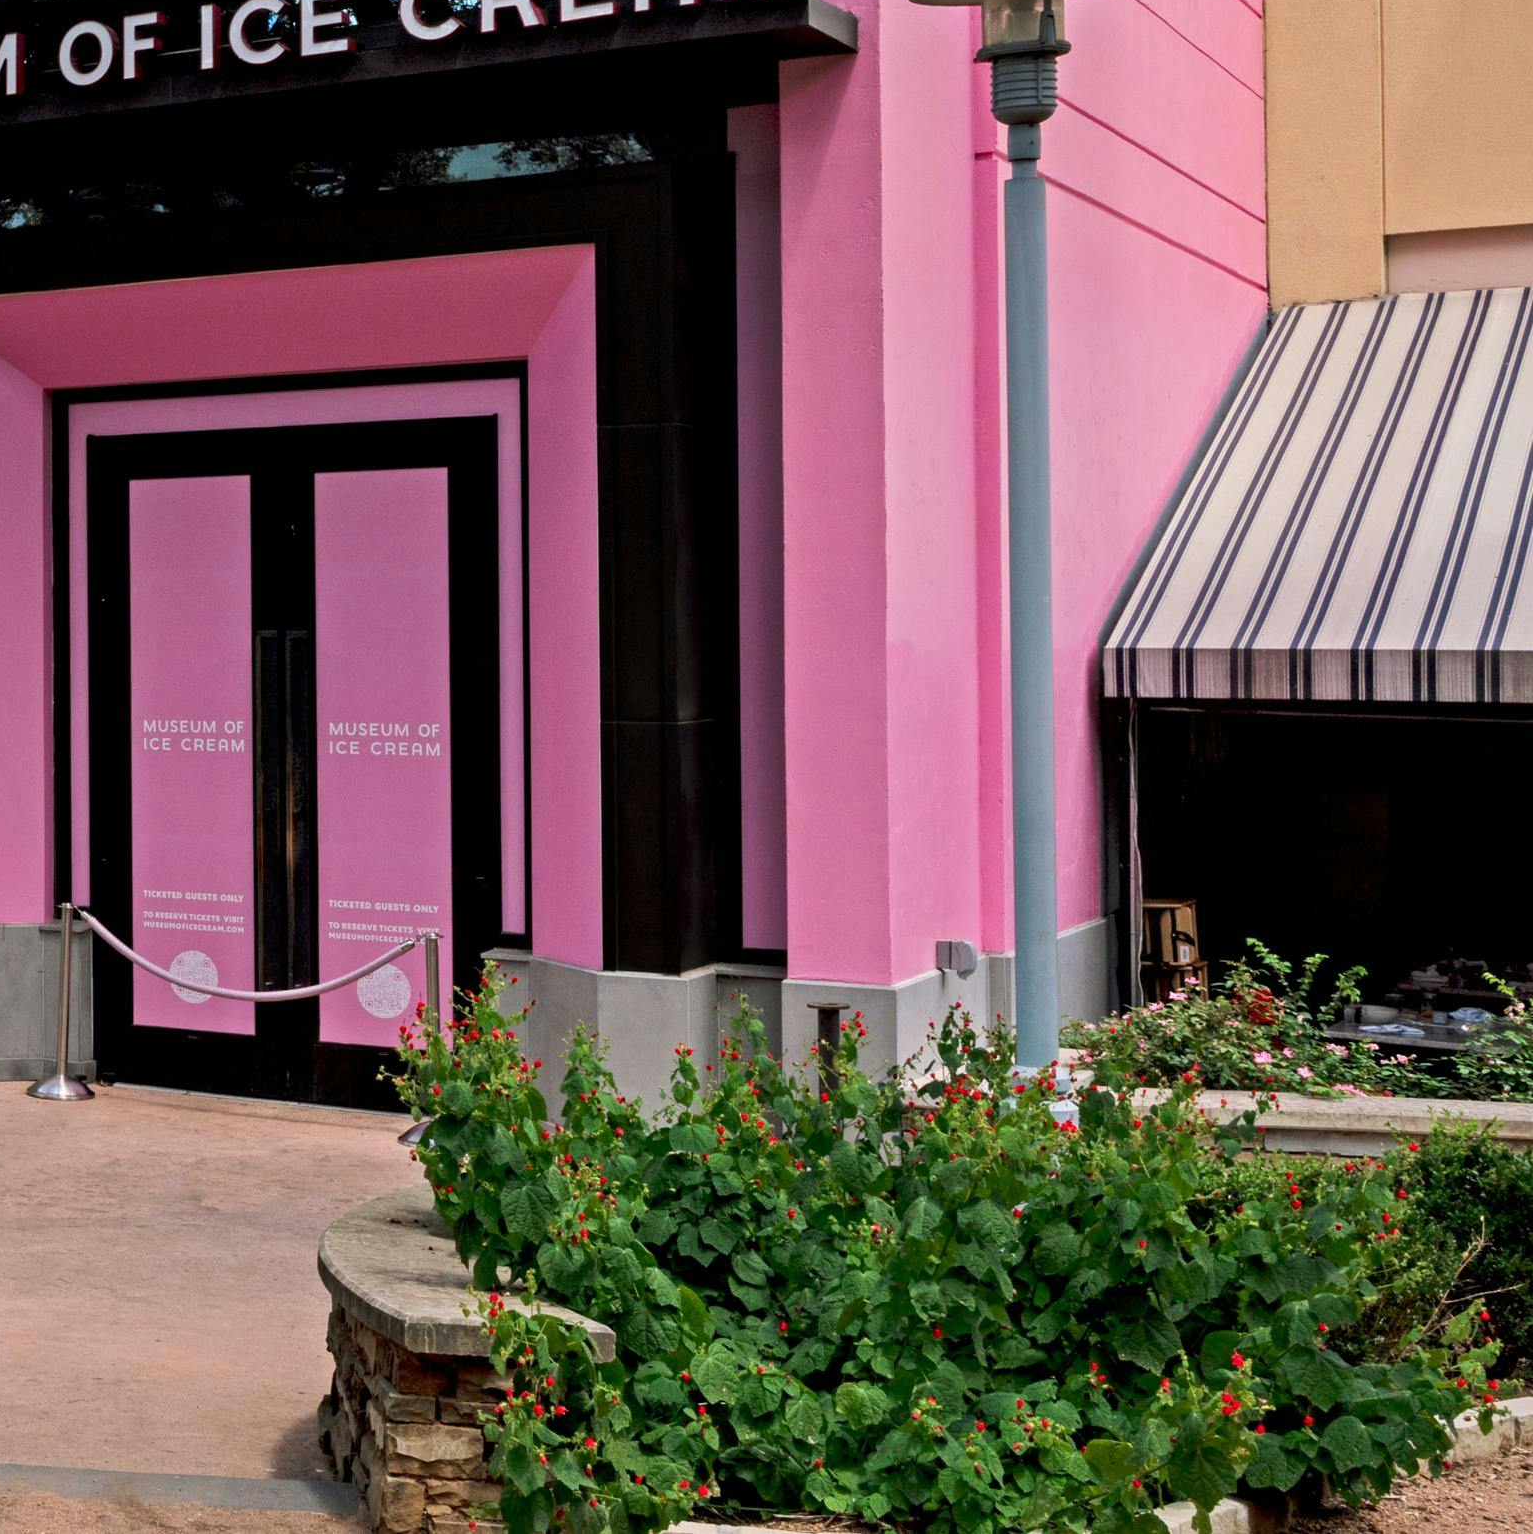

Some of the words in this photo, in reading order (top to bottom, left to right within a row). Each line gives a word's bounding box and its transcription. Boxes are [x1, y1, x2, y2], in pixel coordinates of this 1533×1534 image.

[58, 11, 165, 87] OF
[143, 719, 217, 734] MUSEUM
[224, 720, 244, 734] OF
[328, 722, 410, 737] MUSEUM
[418, 723, 440, 738] OF
[143, 737, 172, 751] ICE
[180, 738, 245, 752] CREAM
[329, 740, 360, 755] ICE
[370, 741, 441, 757] CREAM
[143, 889, 183, 899] TICKETED
[185, 891, 218, 902] GUESTS
[220, 894, 244, 903] ONLY
[328, 899, 372, 910] TICKETED
[374, 902, 411, 912] GUESTS
[413, 904, 439, 914] ONLY
[143, 911, 154, 919] TO
[155, 911, 187, 920] RESERVE
[189, 913, 220, 922] TICKETS
[223, 915, 244, 923] VISIT
[143, 921, 245, 934] MUSEUMOFICECREAM.COM
[341, 922, 377, 932] RESERVE
[379, 924, 413, 934] TICKETS
